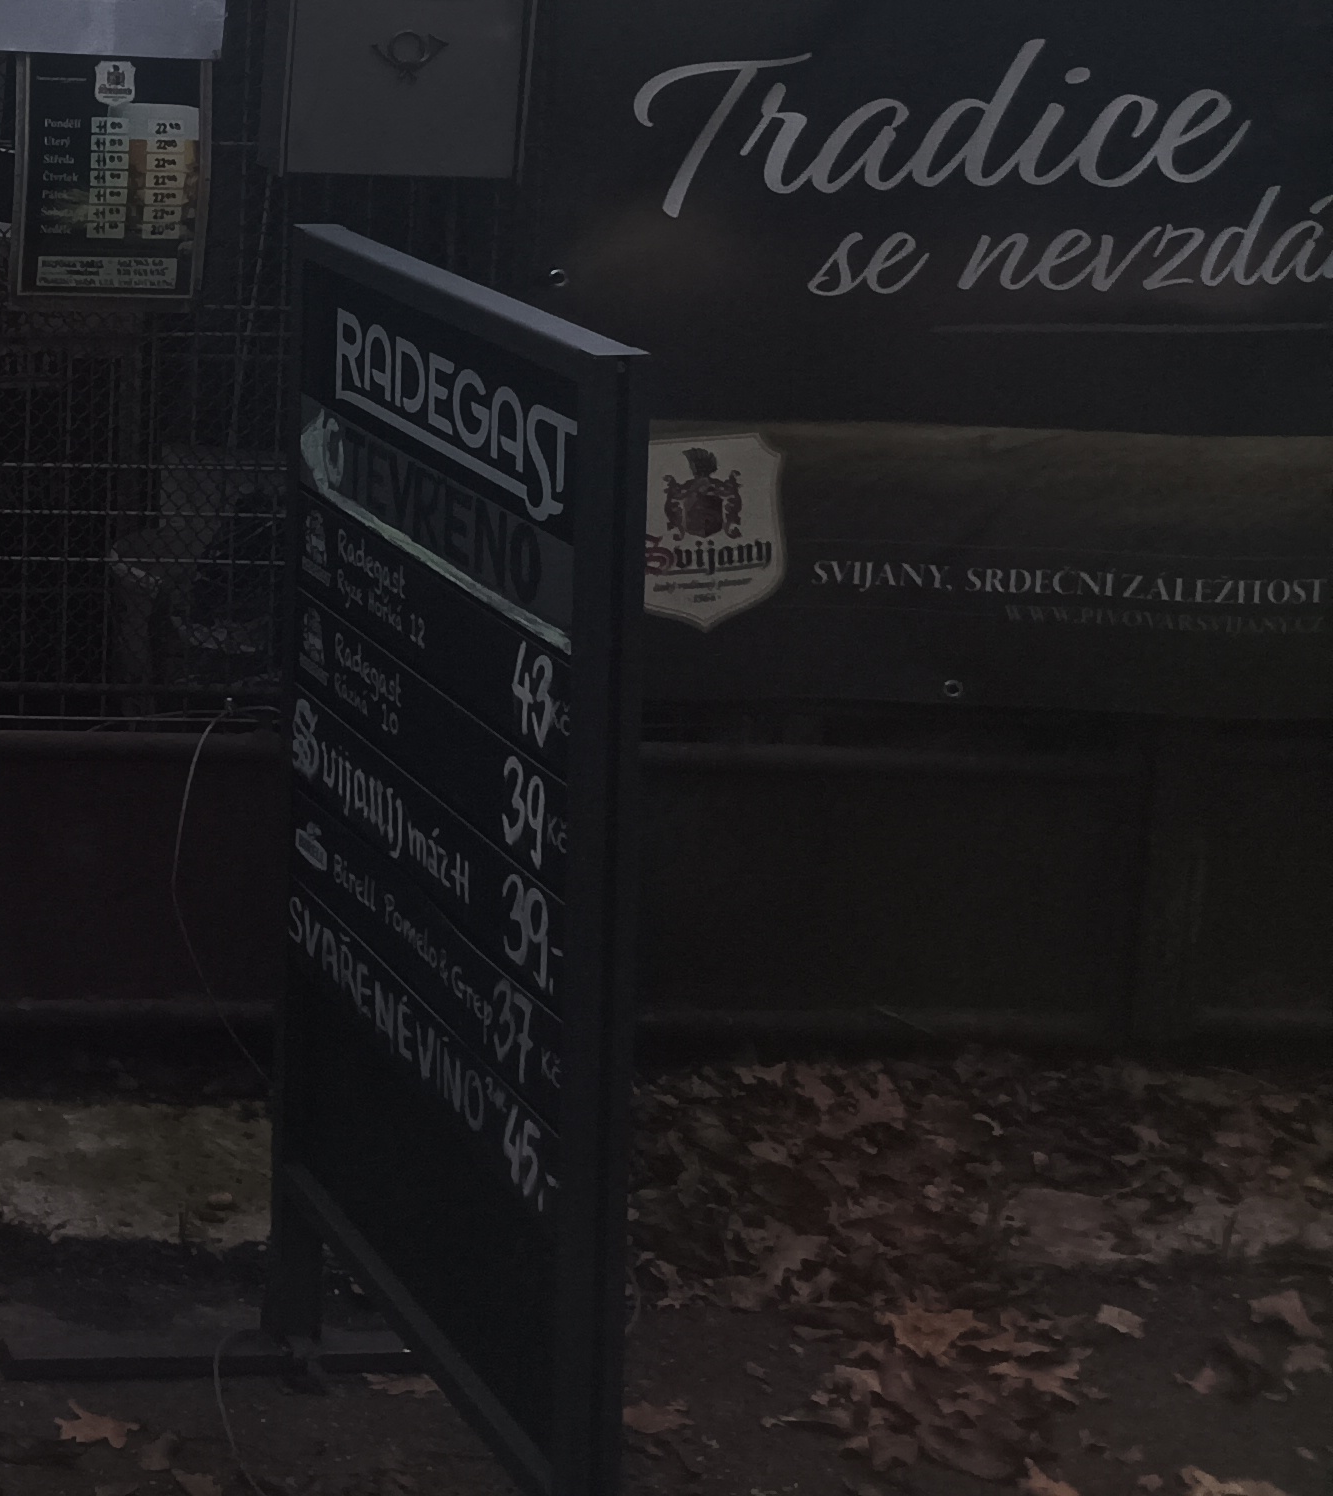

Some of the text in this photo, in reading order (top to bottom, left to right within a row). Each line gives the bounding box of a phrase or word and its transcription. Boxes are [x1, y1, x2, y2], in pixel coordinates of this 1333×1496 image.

[633, 38, 1252, 218] Tradice
[808, 185, 1333, 296] se nevzdá
[335, 307, 579, 522] RADEGAST
[337, 528, 406, 600] Radegast
[811, 559, 1328, 605] SVIJANY, SRDEČNÍ ZÁLEŽITOST
[334, 631, 402, 708] Radegast
[409, 612, 425, 650] 12
[381, 703, 400, 737] 10
[511, 639, 554, 749] 43
[291, 698, 404, 860] Svijany
[501, 755, 546, 870] 39
[333, 853, 377, 912] Birell
[384, 893, 437, 969] Pomelo
[450, 965, 494, 1045] Grep
[493, 977, 534, 1085] 37
